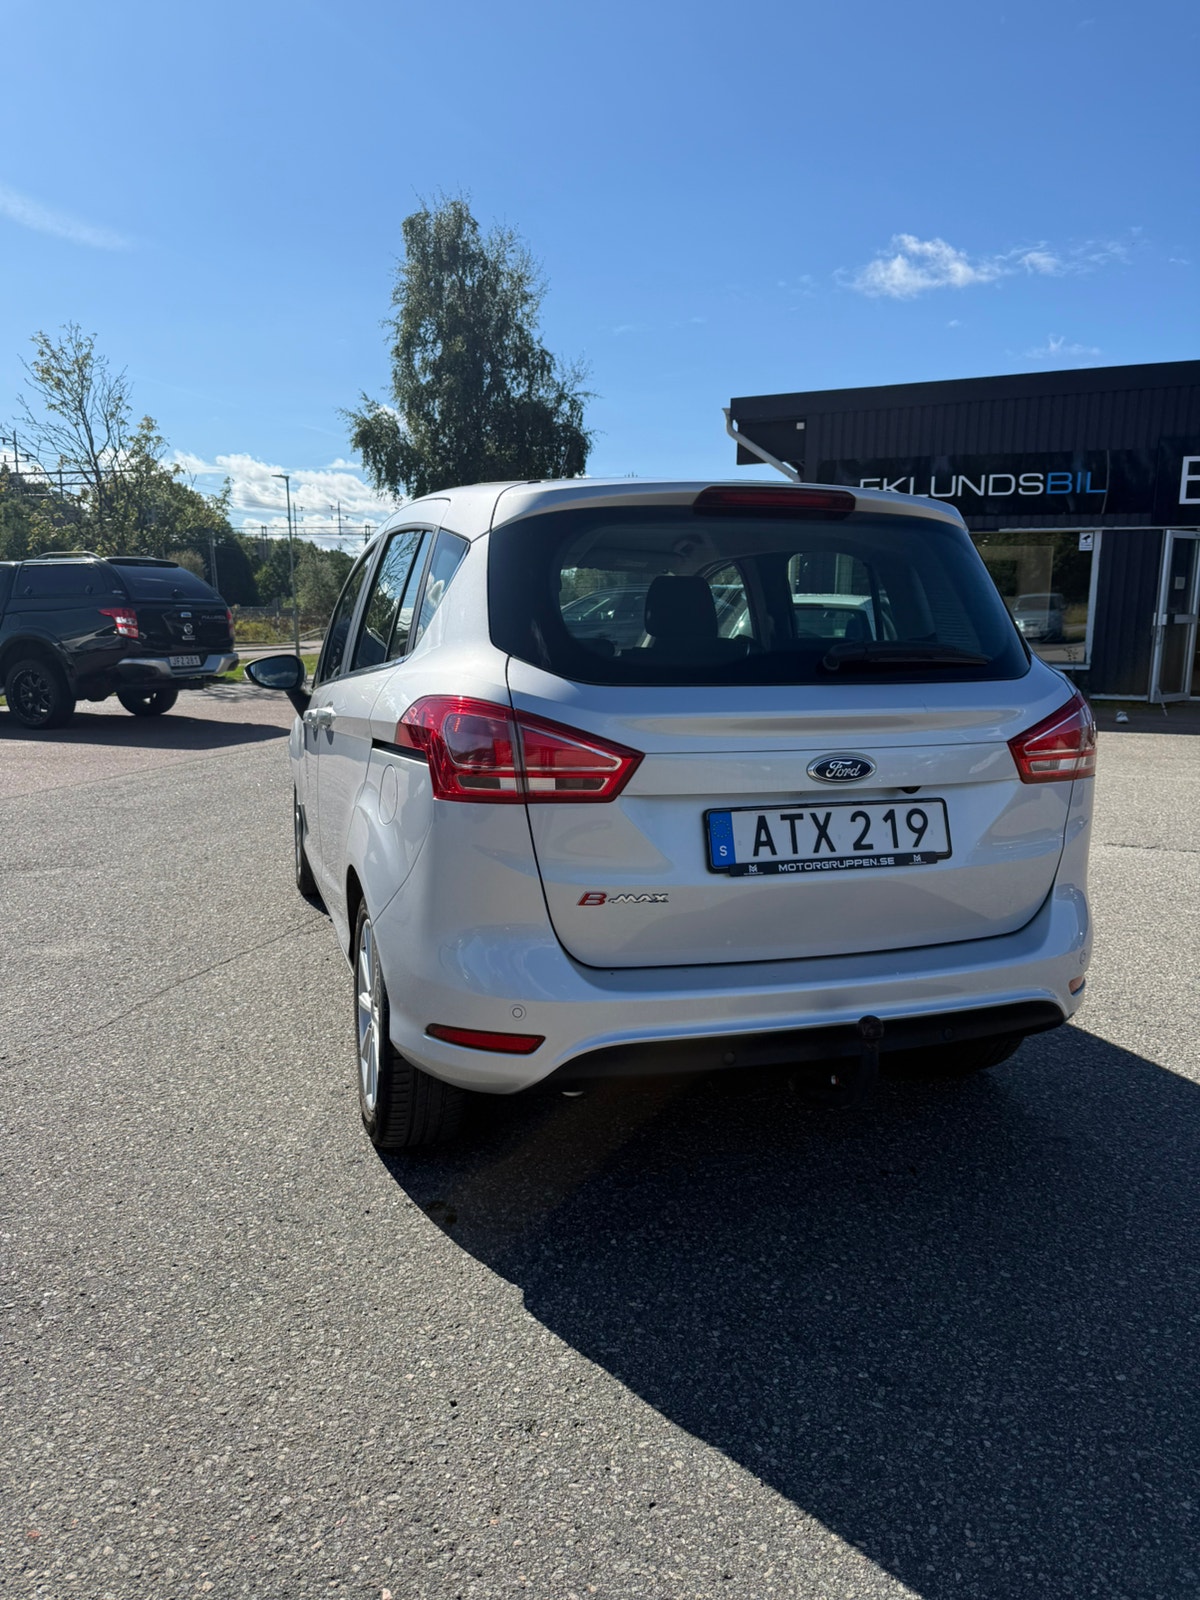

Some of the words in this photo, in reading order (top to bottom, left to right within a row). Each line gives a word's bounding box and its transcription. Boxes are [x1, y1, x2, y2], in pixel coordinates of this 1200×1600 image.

[825, 760, 862, 778] Ford
[752, 811, 837, 857] ATX
[850, 807, 929, 851] 219
[719, 845, 728, 857] S
[778, 856, 896, 872] MOTORGRUPPEN.SE
